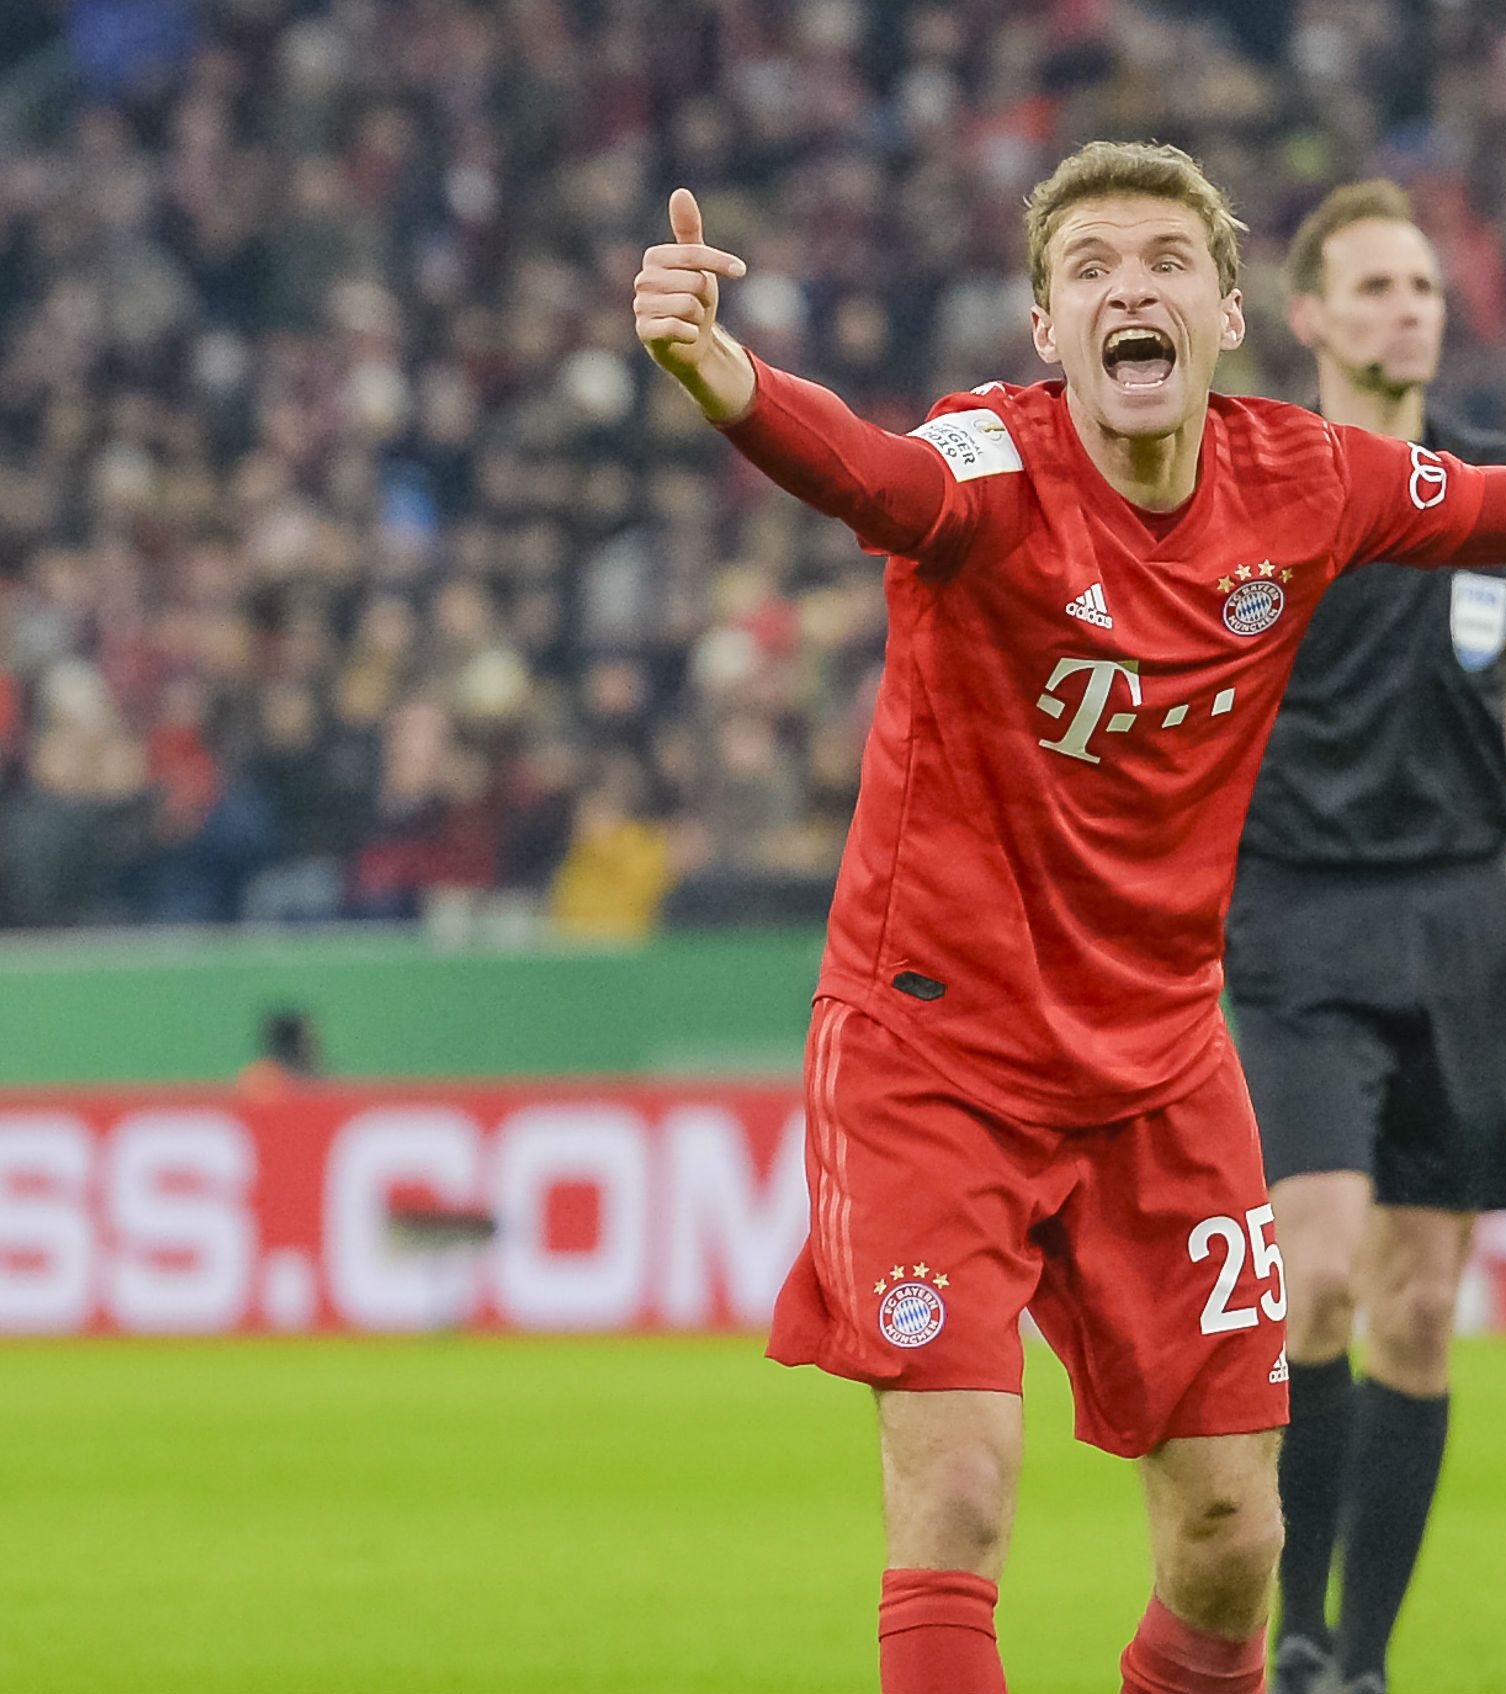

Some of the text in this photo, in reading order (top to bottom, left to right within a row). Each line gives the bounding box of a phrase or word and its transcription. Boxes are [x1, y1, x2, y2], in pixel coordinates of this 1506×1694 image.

[1242, 584, 1280, 601] BAYERN
[1065, 602, 1113, 630] adidas
[1188, 1203, 1287, 1335] 25
[884, 1287, 938, 1314] FC BAYERN
